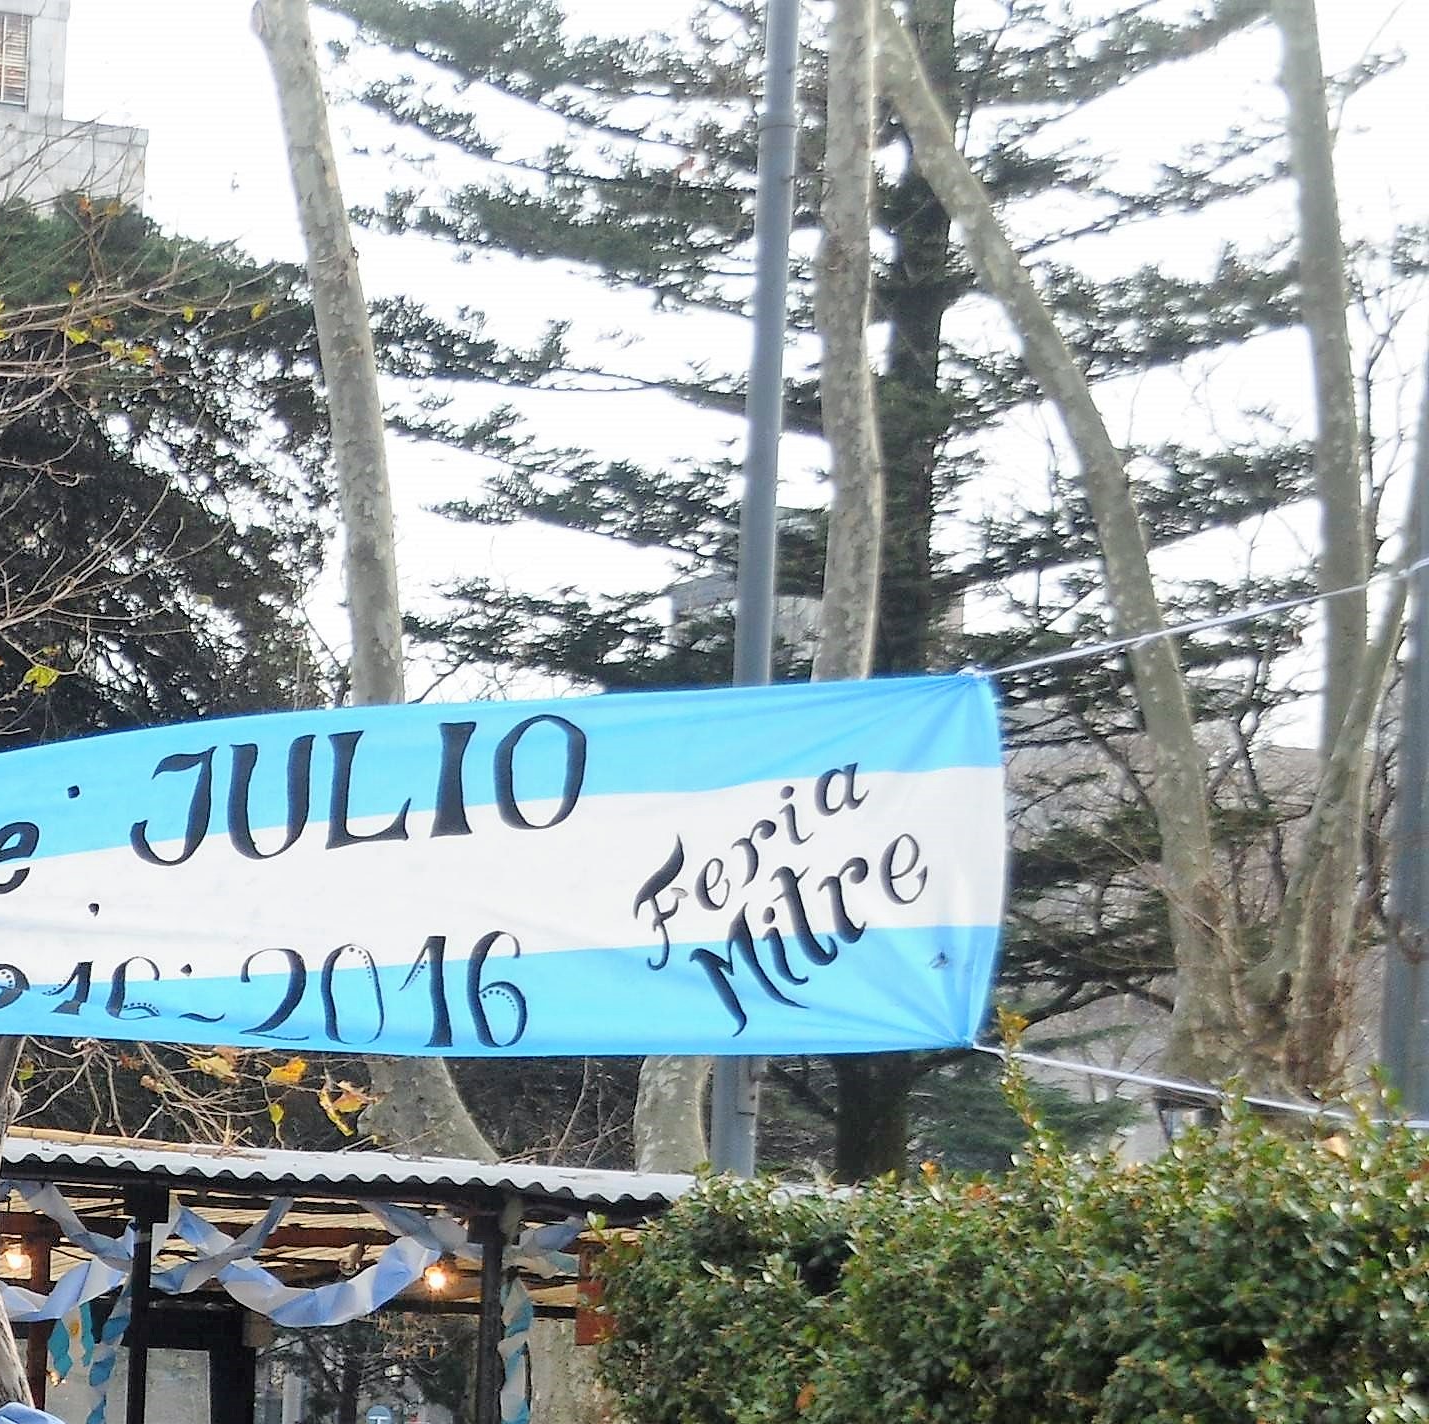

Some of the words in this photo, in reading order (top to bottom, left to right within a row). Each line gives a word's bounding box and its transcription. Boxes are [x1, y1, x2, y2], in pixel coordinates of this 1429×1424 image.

[130, 714, 587, 866] JULIO
[633, 761, 869, 971] Feria
[689, 833, 928, 1037] Mitre
